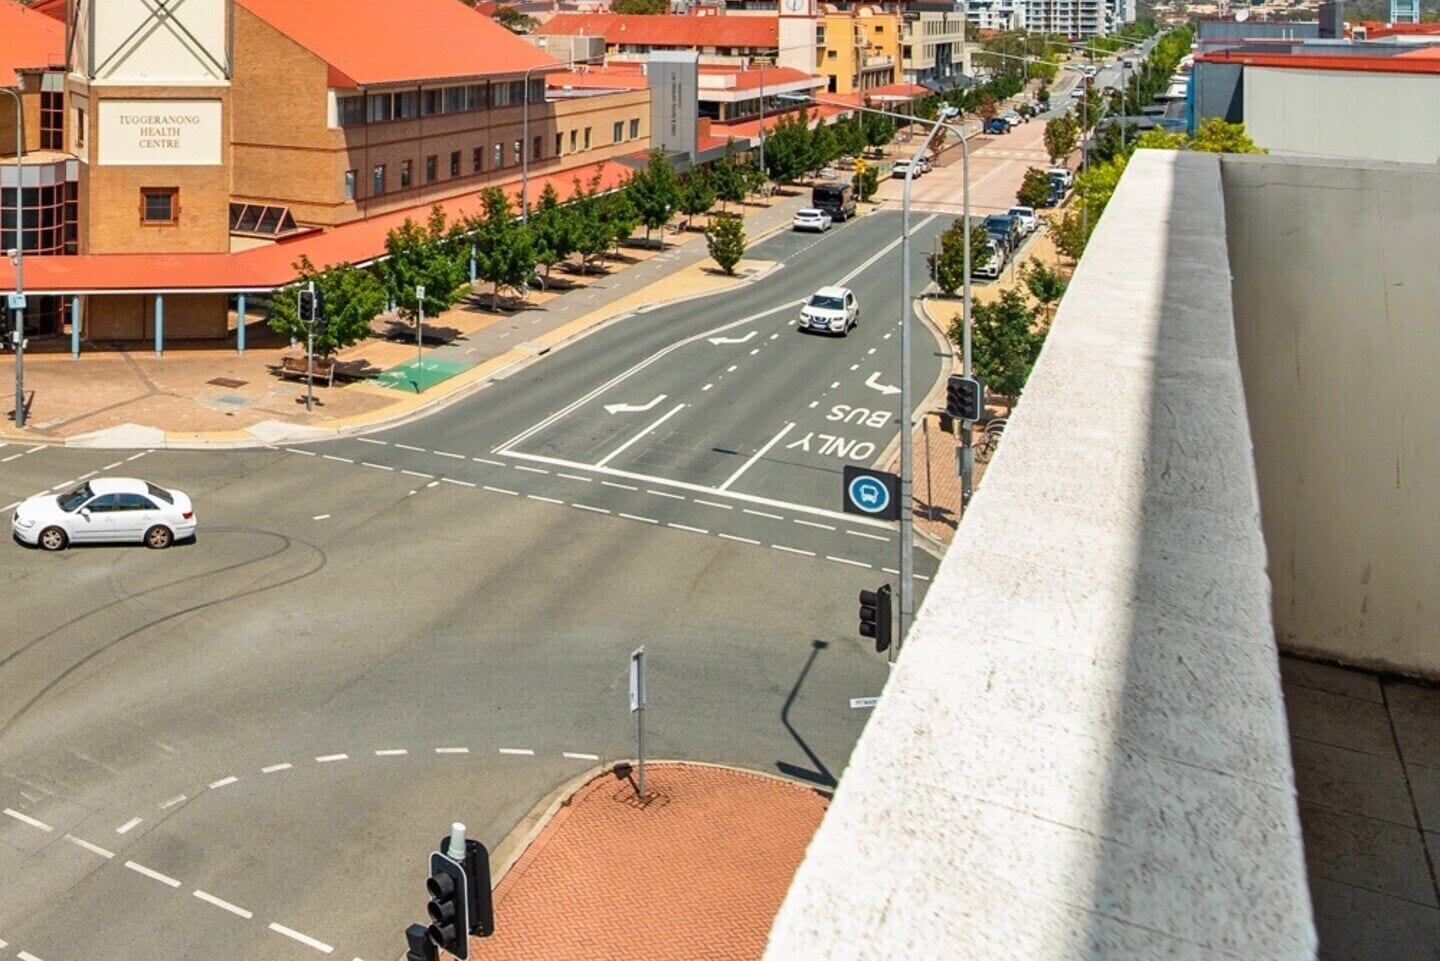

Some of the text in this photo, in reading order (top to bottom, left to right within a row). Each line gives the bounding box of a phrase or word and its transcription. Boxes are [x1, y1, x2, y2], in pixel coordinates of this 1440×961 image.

[119, 115, 200, 125] TUGGERANONG
[140, 127, 181, 136] HEALTH
[139, 139, 181, 148] CENTRE
[826, 405, 893, 428] BUS
[786, 432, 876, 460] ONLY
